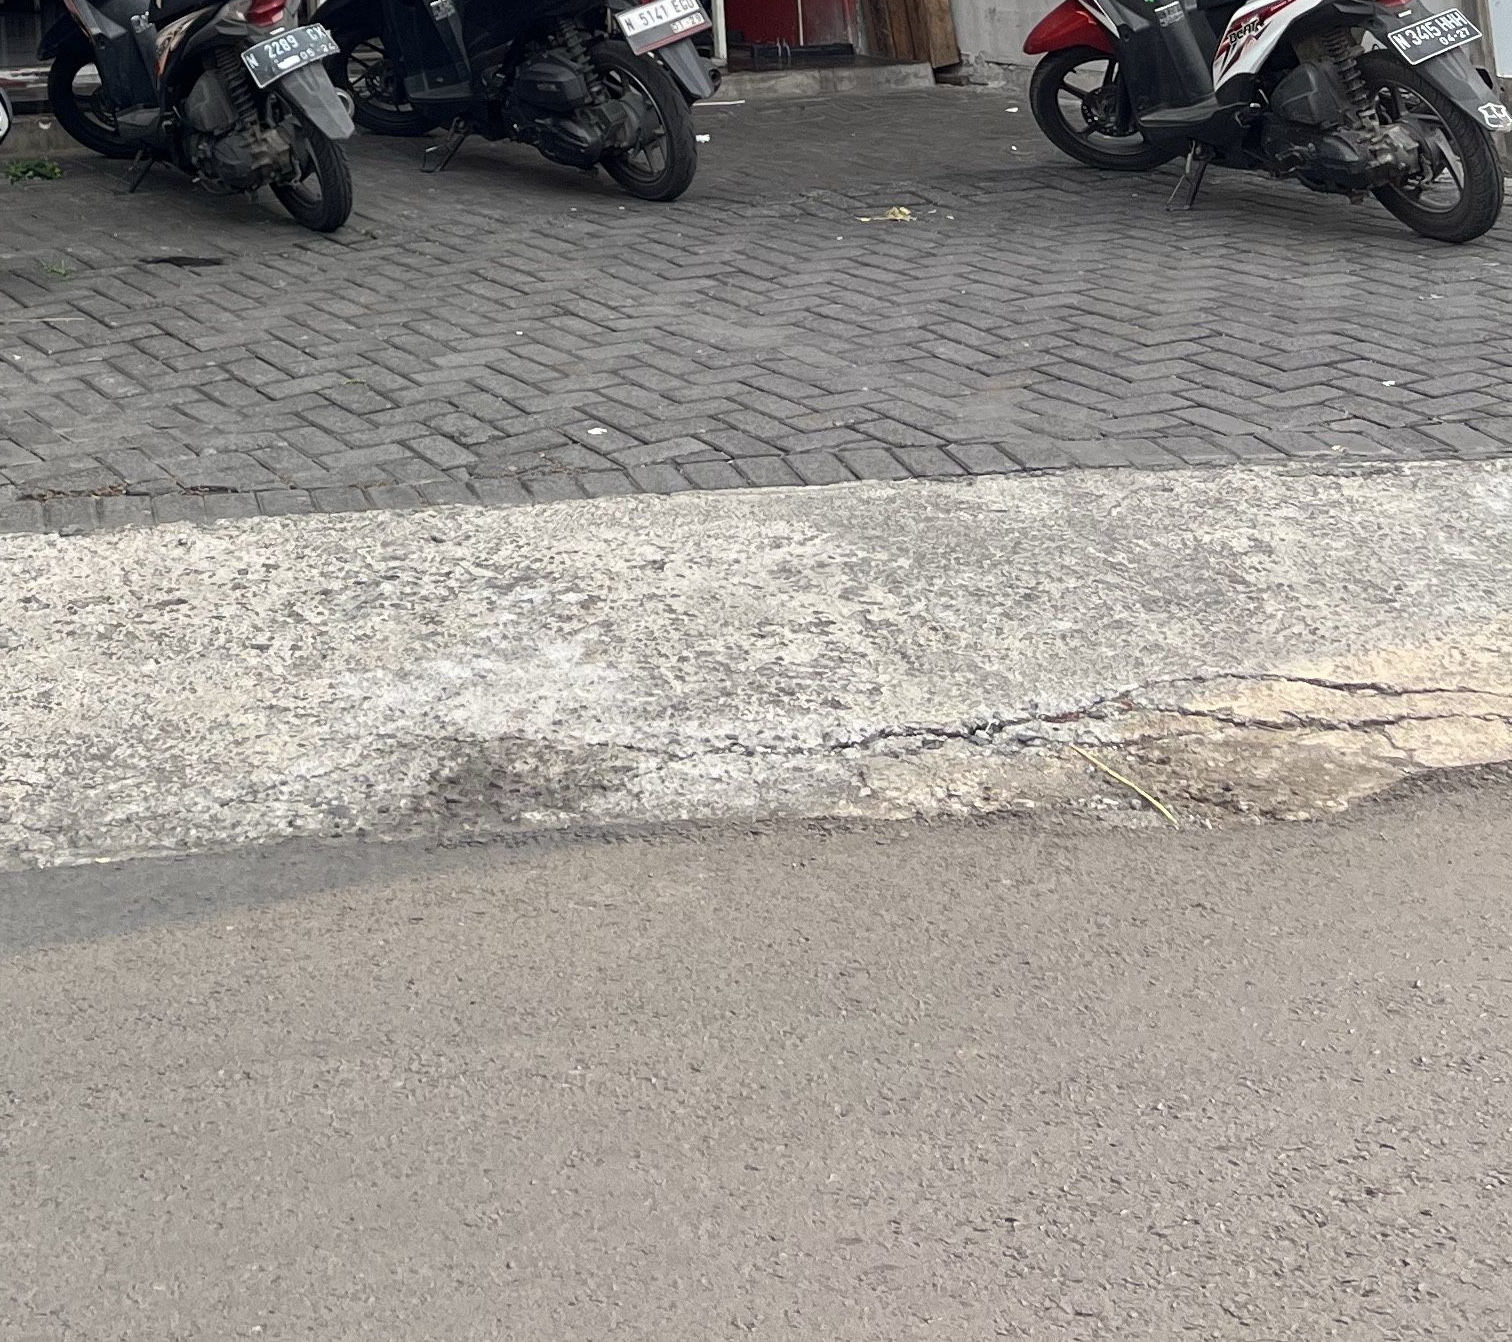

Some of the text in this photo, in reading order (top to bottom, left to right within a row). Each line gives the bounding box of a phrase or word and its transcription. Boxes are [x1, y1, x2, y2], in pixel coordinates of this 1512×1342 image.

[624, 18, 636, 32] N
[638, 4, 668, 27] 5141
[1393, 11, 1468, 51] N 3415 HHH
[246, 53, 259, 69] N
[264, 34, 299, 59] 2289
